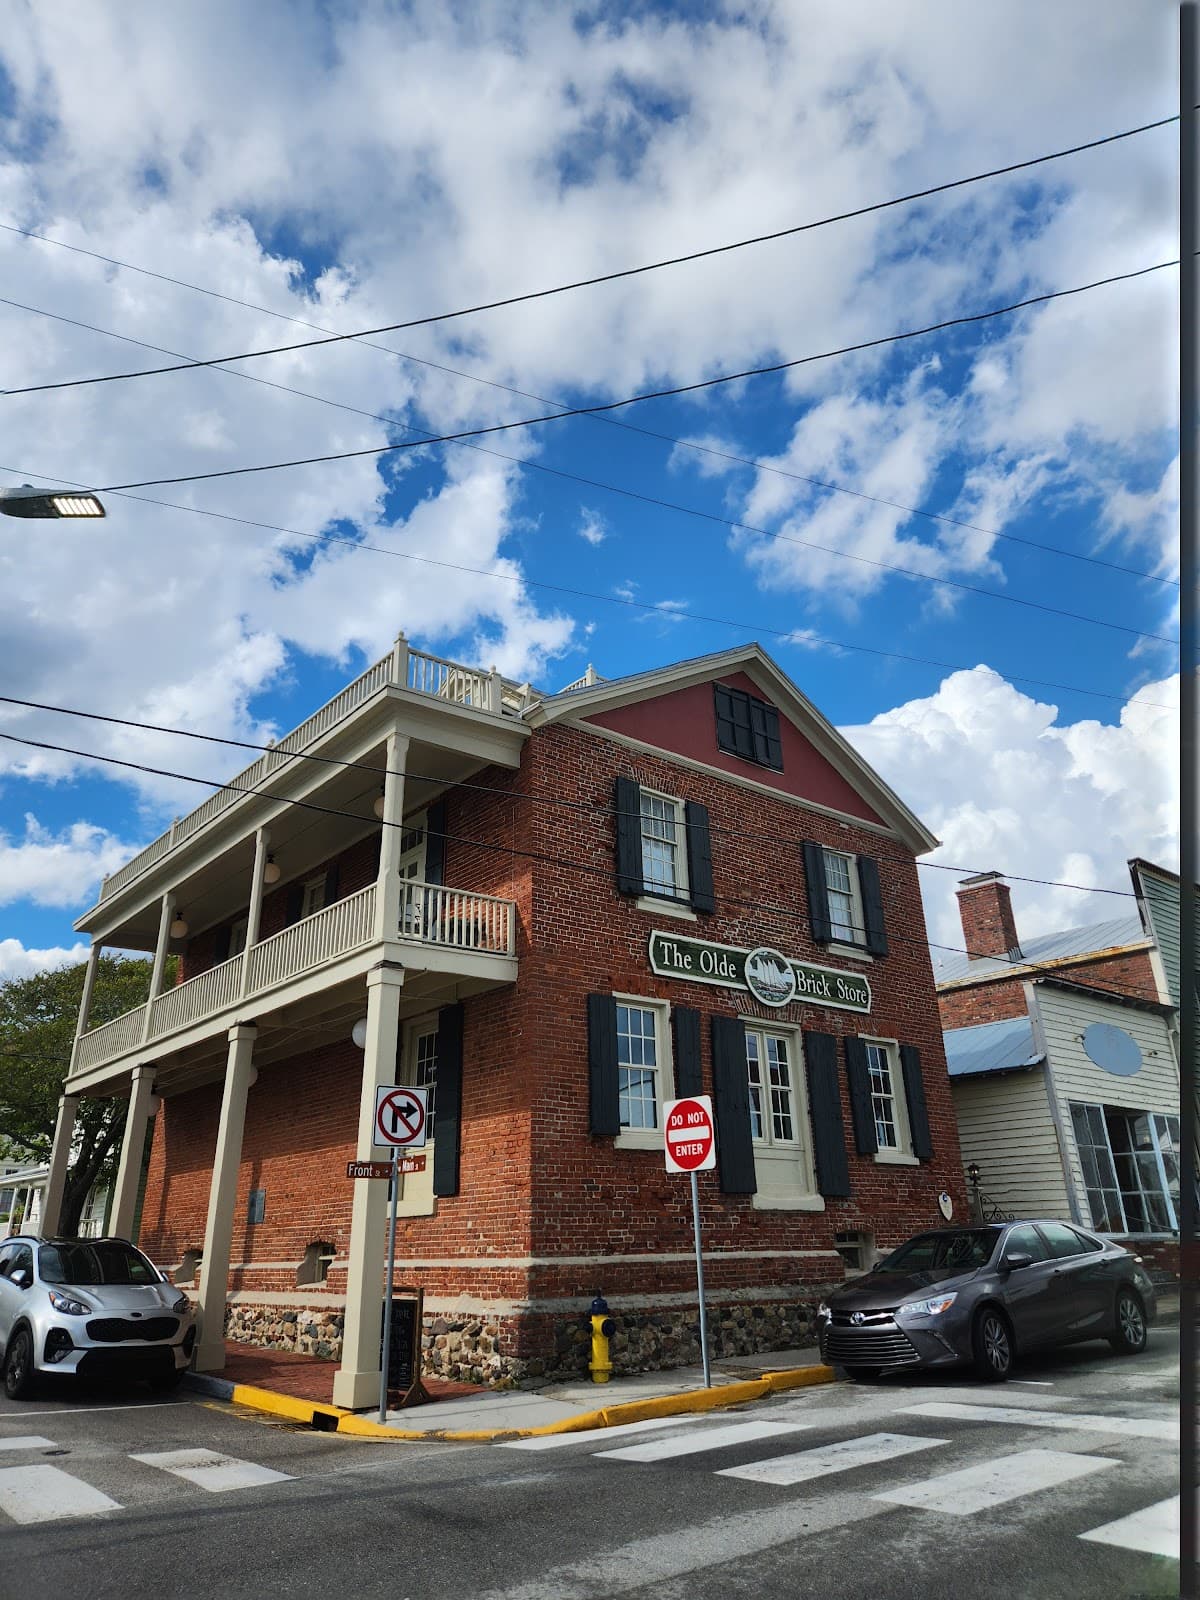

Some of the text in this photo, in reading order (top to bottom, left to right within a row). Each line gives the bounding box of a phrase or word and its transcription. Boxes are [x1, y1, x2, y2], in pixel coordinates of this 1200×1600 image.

[660, 941, 867, 1004] The Olde Brick Store
[671, 1112, 704, 1127] DO NOT
[675, 1143, 703, 1157] ENTER
[348, 1163, 373, 1176] Front
[402, 1159, 415, 1172] Main
